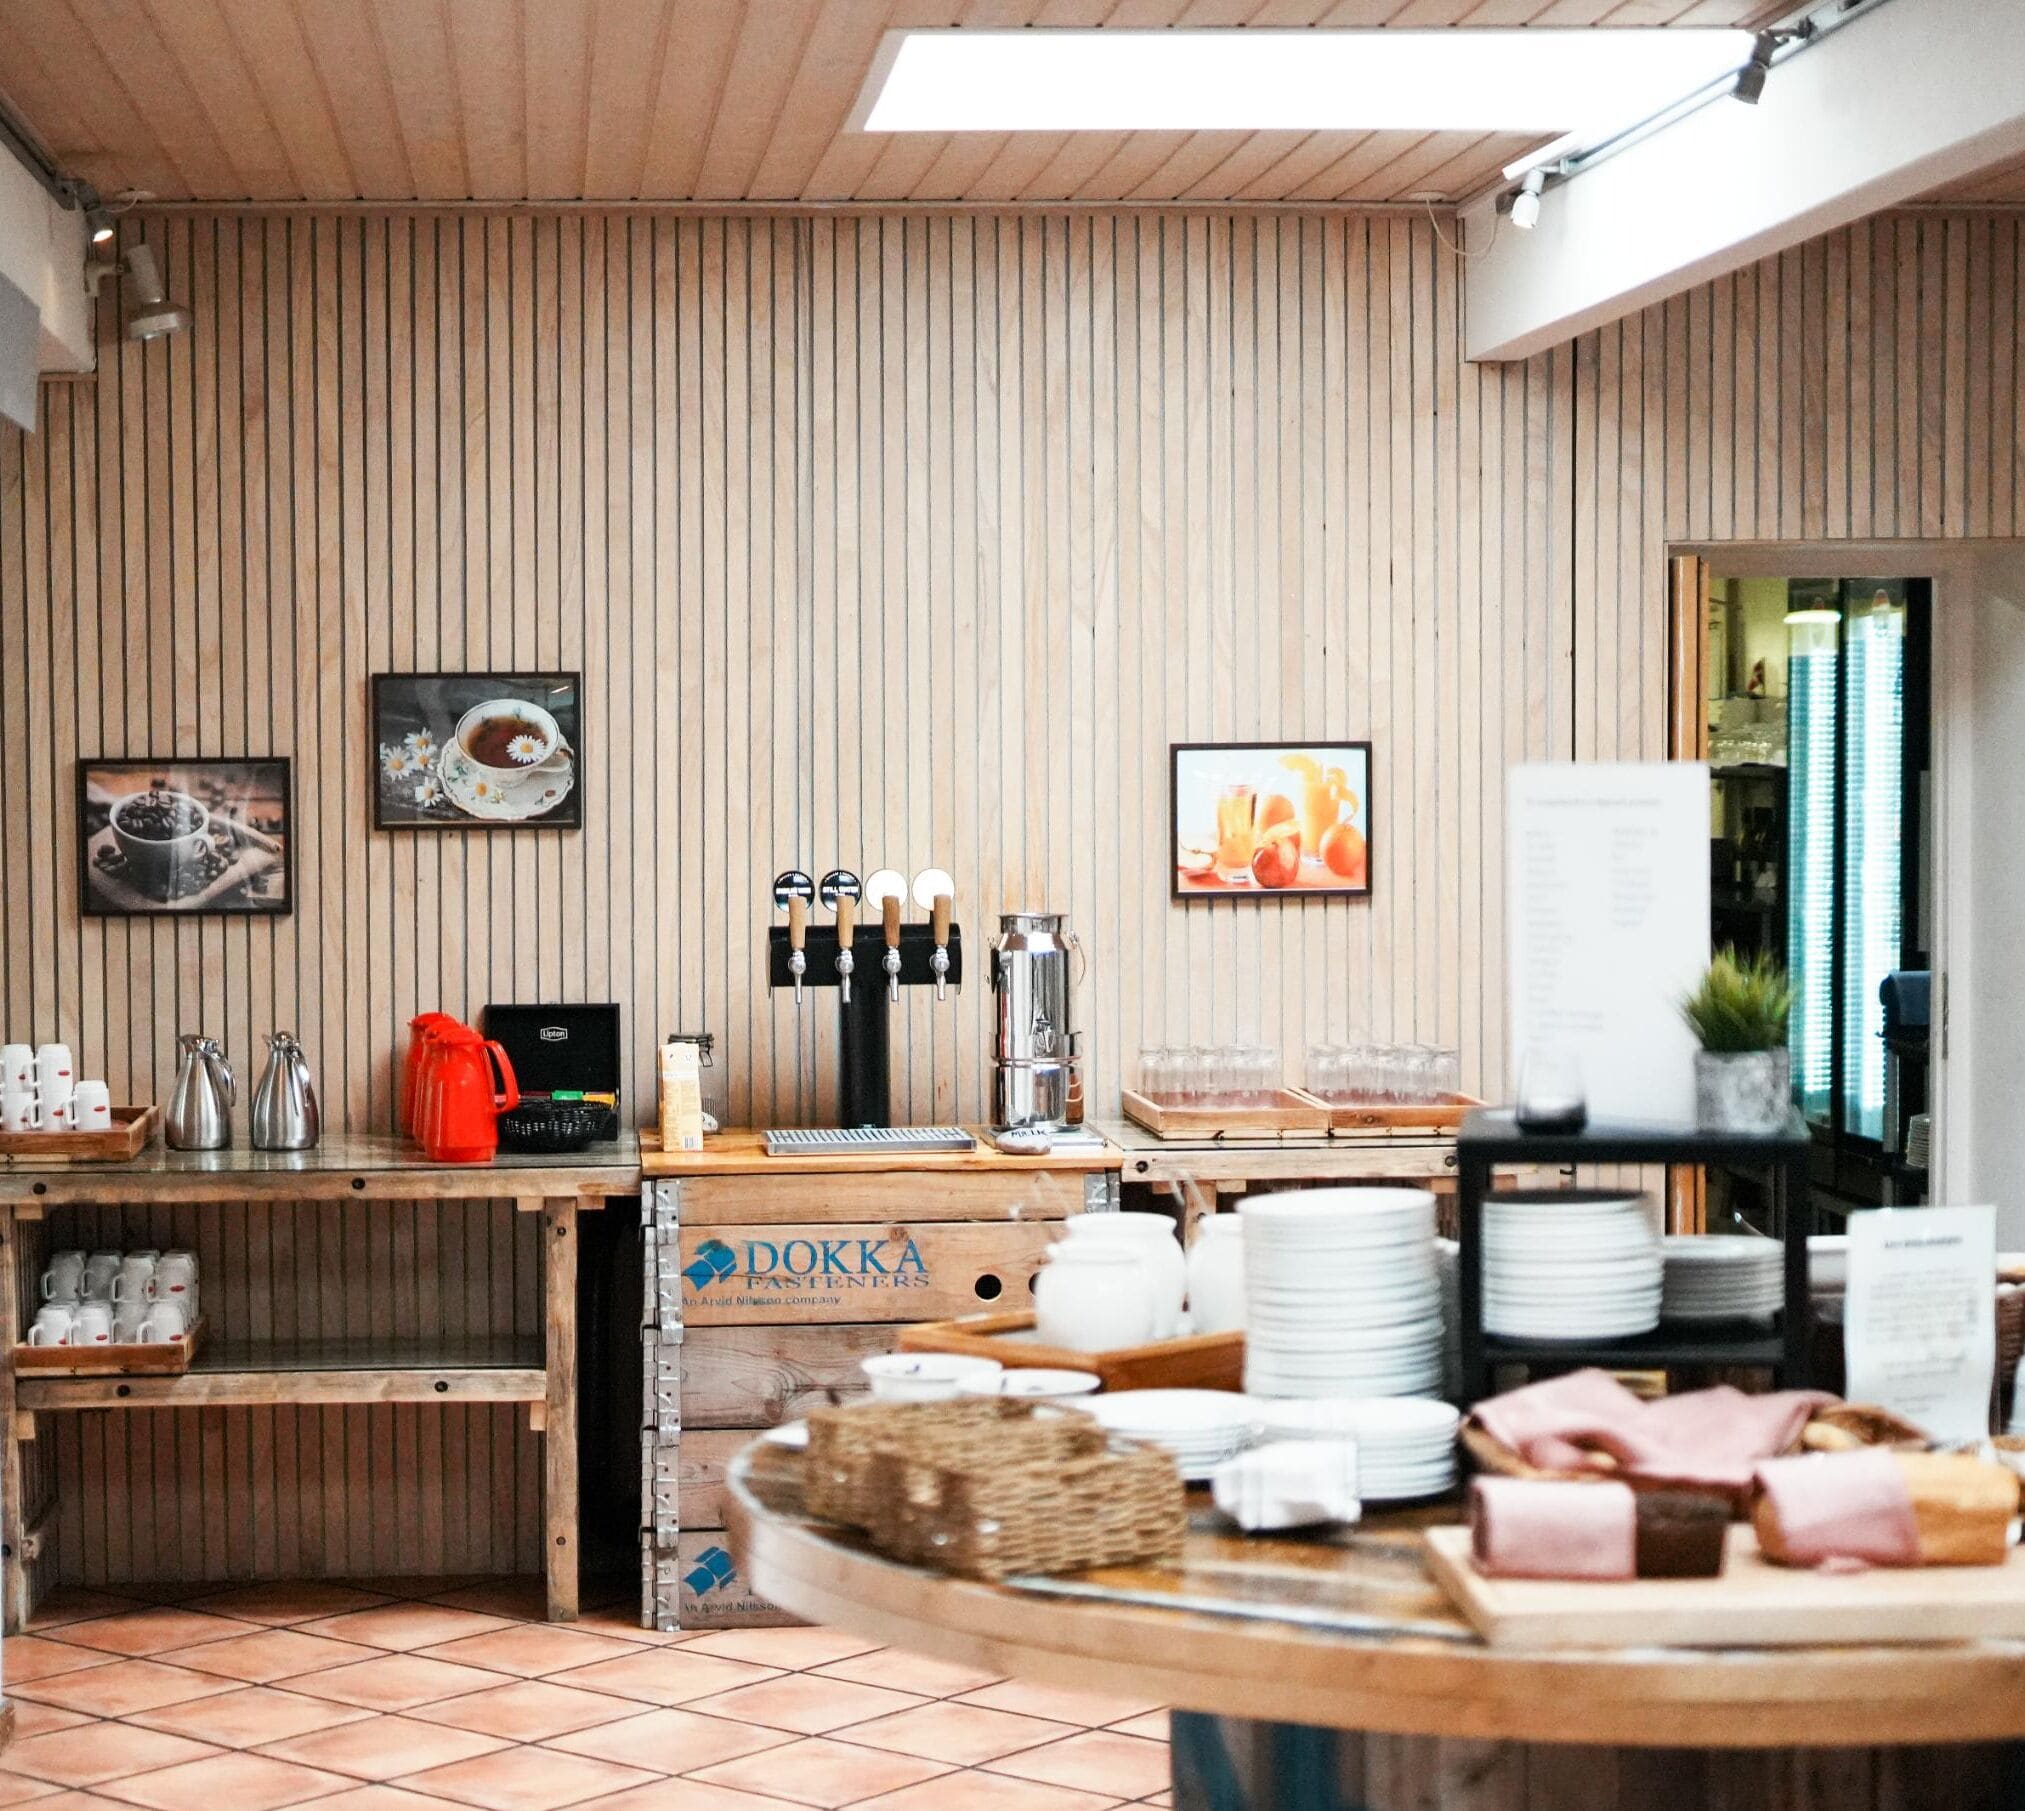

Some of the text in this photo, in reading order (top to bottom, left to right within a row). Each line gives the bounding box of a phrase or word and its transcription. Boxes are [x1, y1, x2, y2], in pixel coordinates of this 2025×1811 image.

[543, 1029, 565, 1038] Lipton
[743, 1239, 929, 1275] DOKKA
[747, 1274, 929, 1289] FASTENERS
[702, 1296, 732, 1306] Arvid
